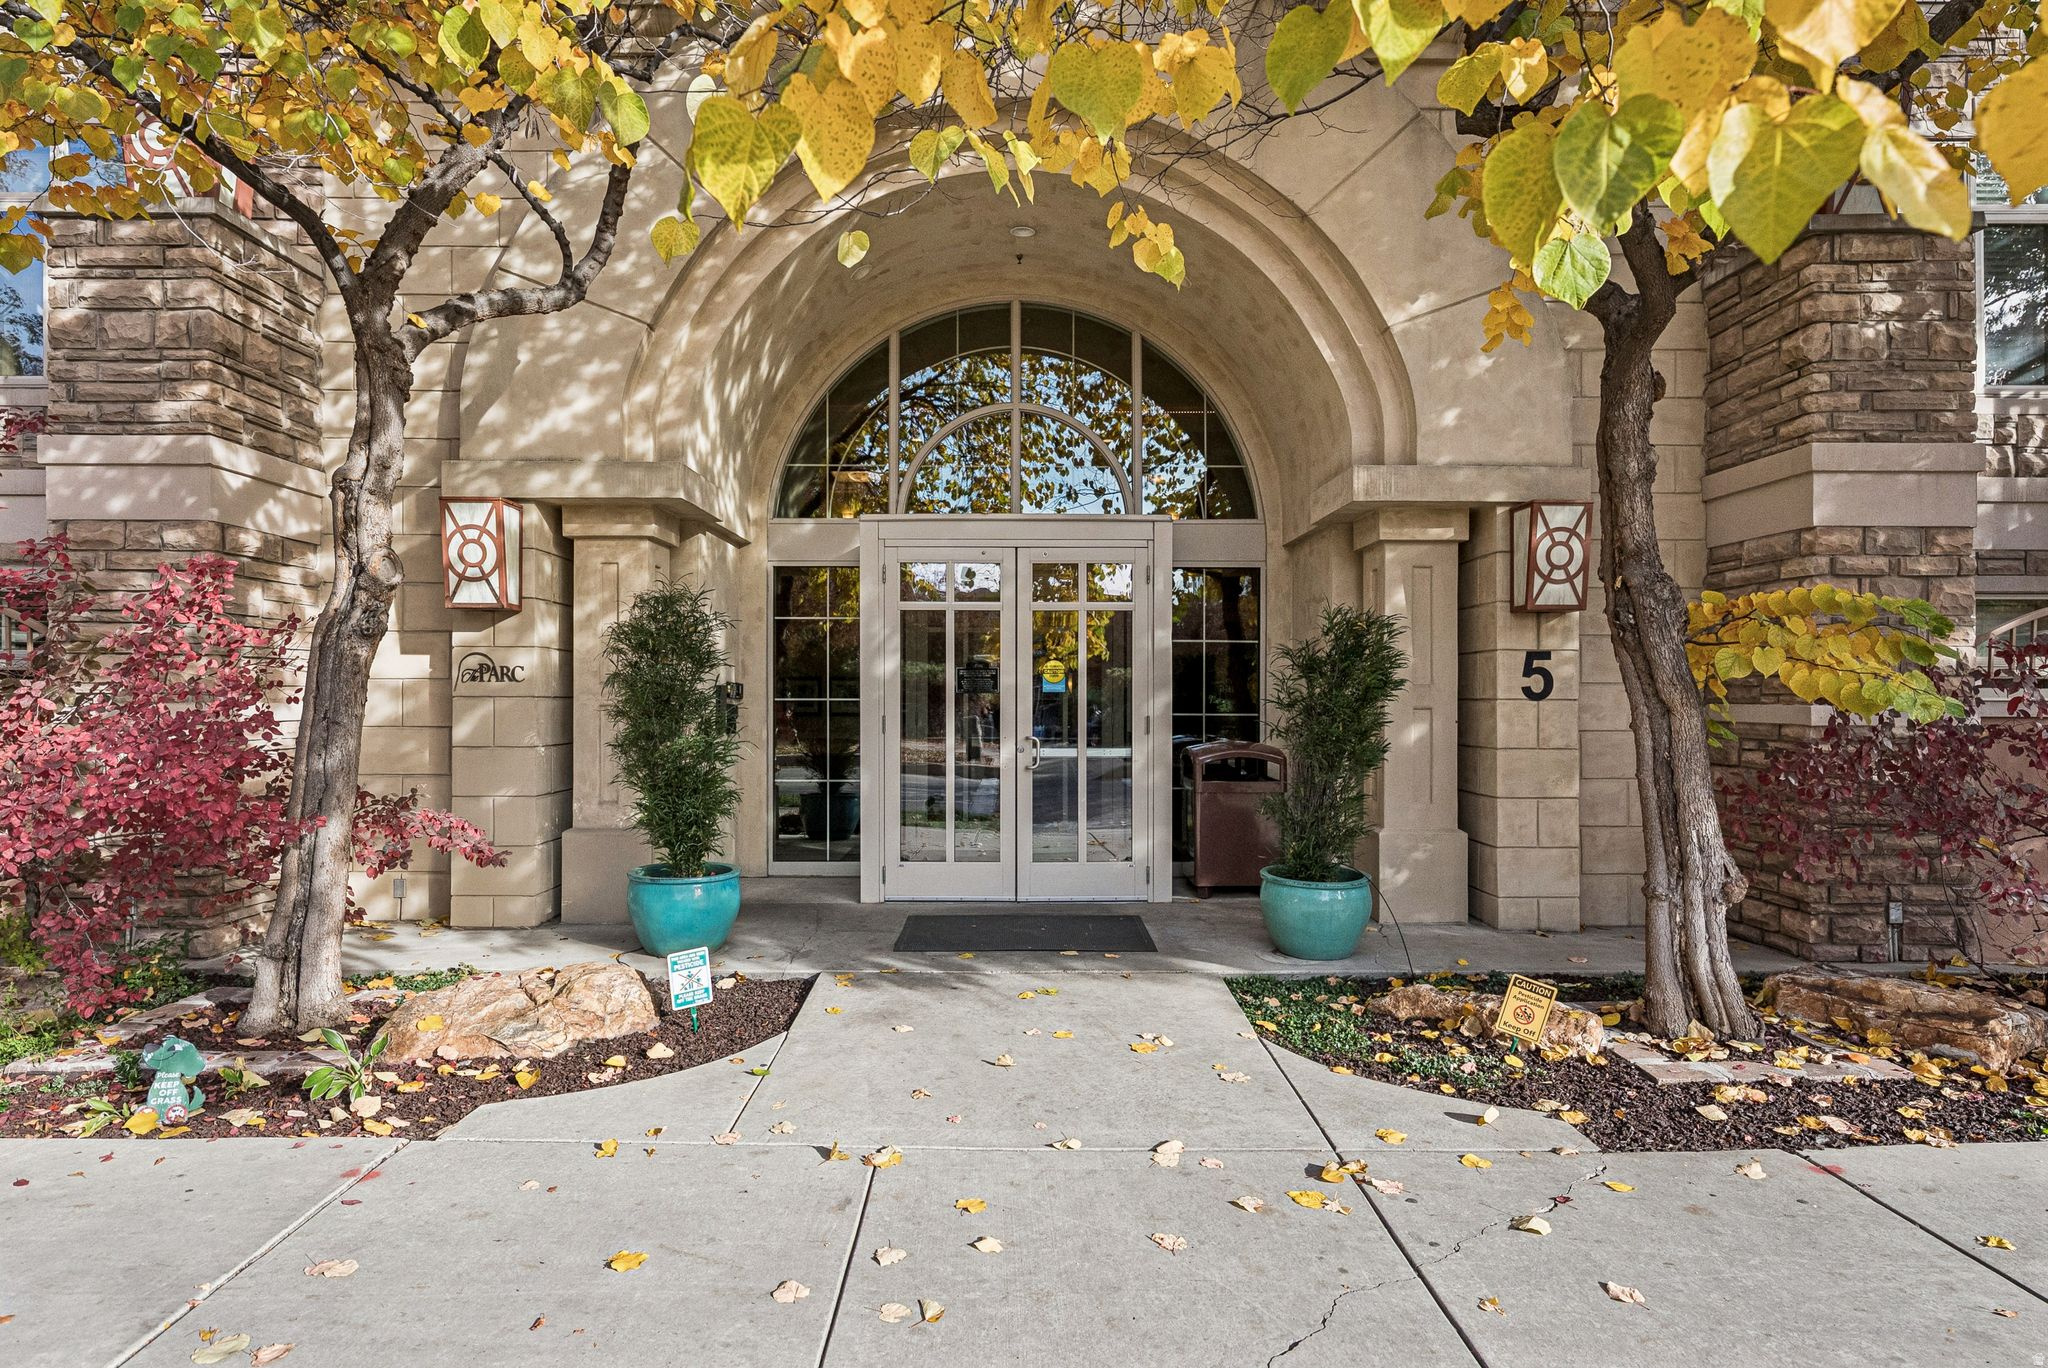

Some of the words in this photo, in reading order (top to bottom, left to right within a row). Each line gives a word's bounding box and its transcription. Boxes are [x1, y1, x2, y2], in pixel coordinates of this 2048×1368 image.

[478, 663, 525, 682] PARC
[1521, 650, 1554, 701] 5
[673, 959, 704, 971] PESTICIDE
[1515, 979, 1552, 998] CAUTION
[1512, 994, 1545, 1010] Application
[1518, 990, 1543, 1003] Pesticide
[1502, 1020, 1522, 1032] Keep
[1522, 1028, 1537, 1038] Off
[153, 1080, 180, 1089] KEEP
[158, 1088, 179, 1097] OFF
[150, 1096, 183, 1105] GRASS
